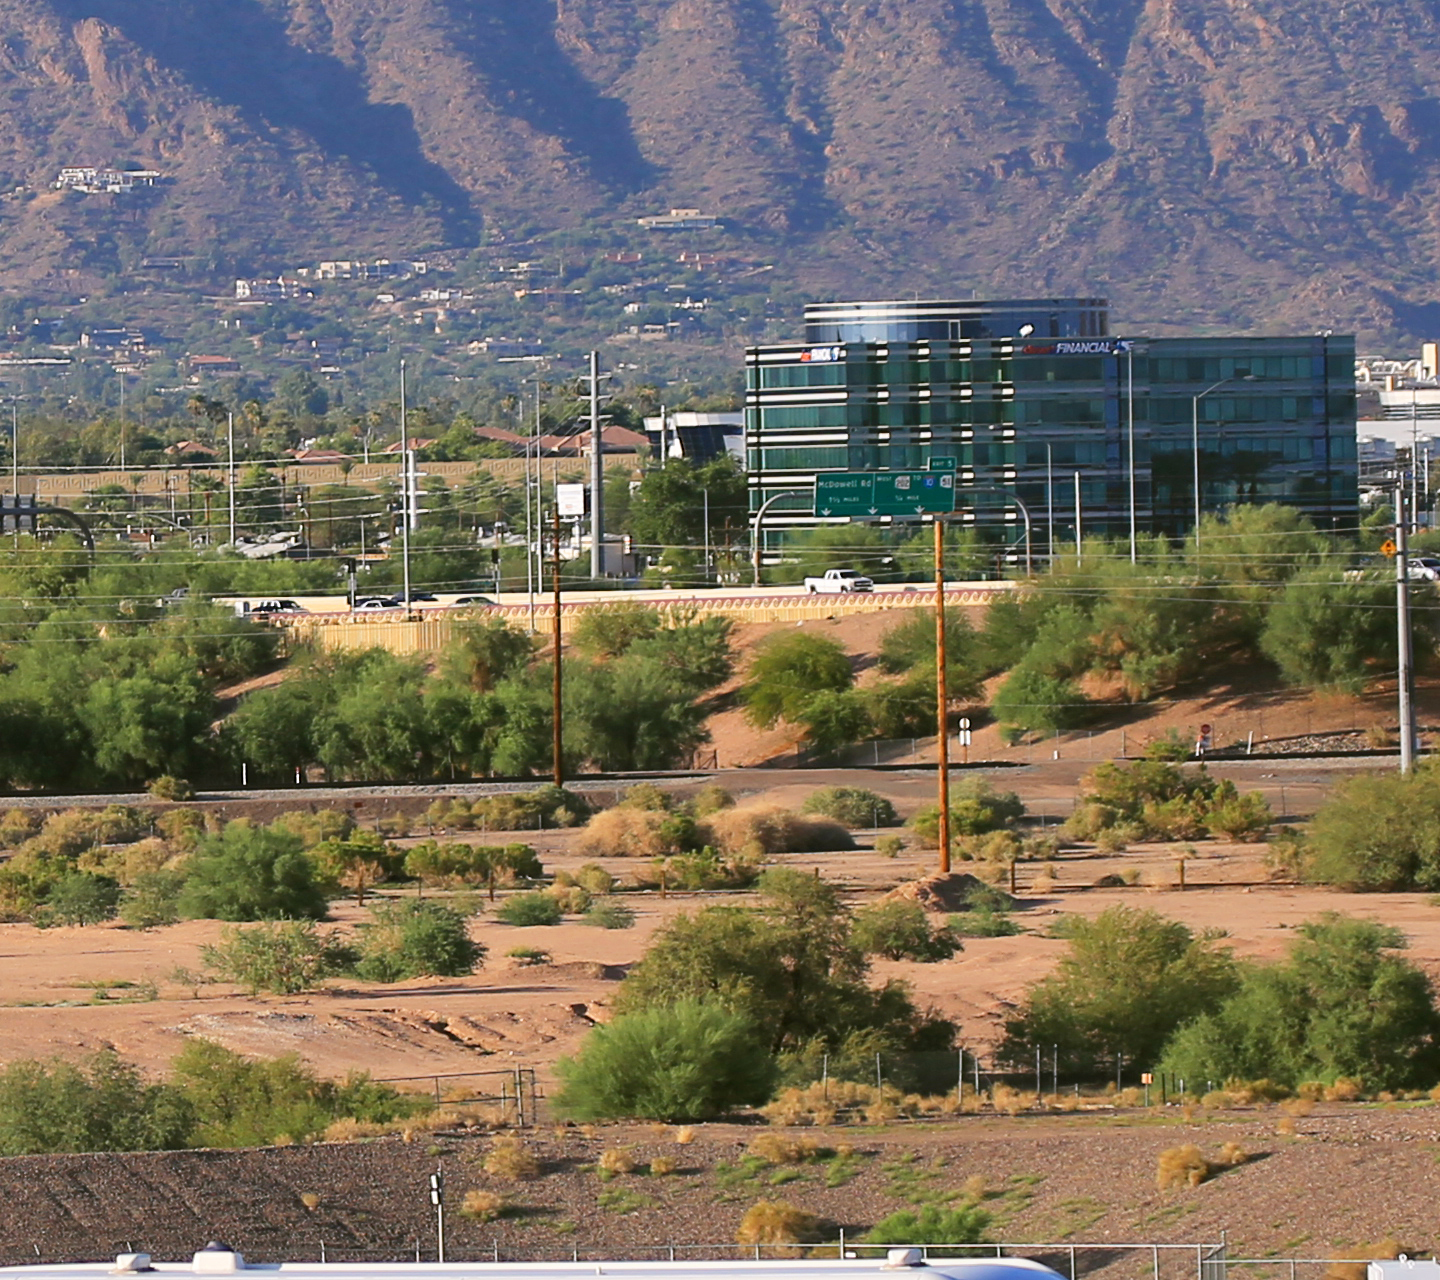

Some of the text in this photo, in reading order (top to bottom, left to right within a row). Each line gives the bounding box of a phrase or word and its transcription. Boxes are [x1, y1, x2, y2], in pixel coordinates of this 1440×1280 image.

[1056, 341, 1111, 354] FINANCIAL
[818, 479, 871, 489] McDowell Rd
